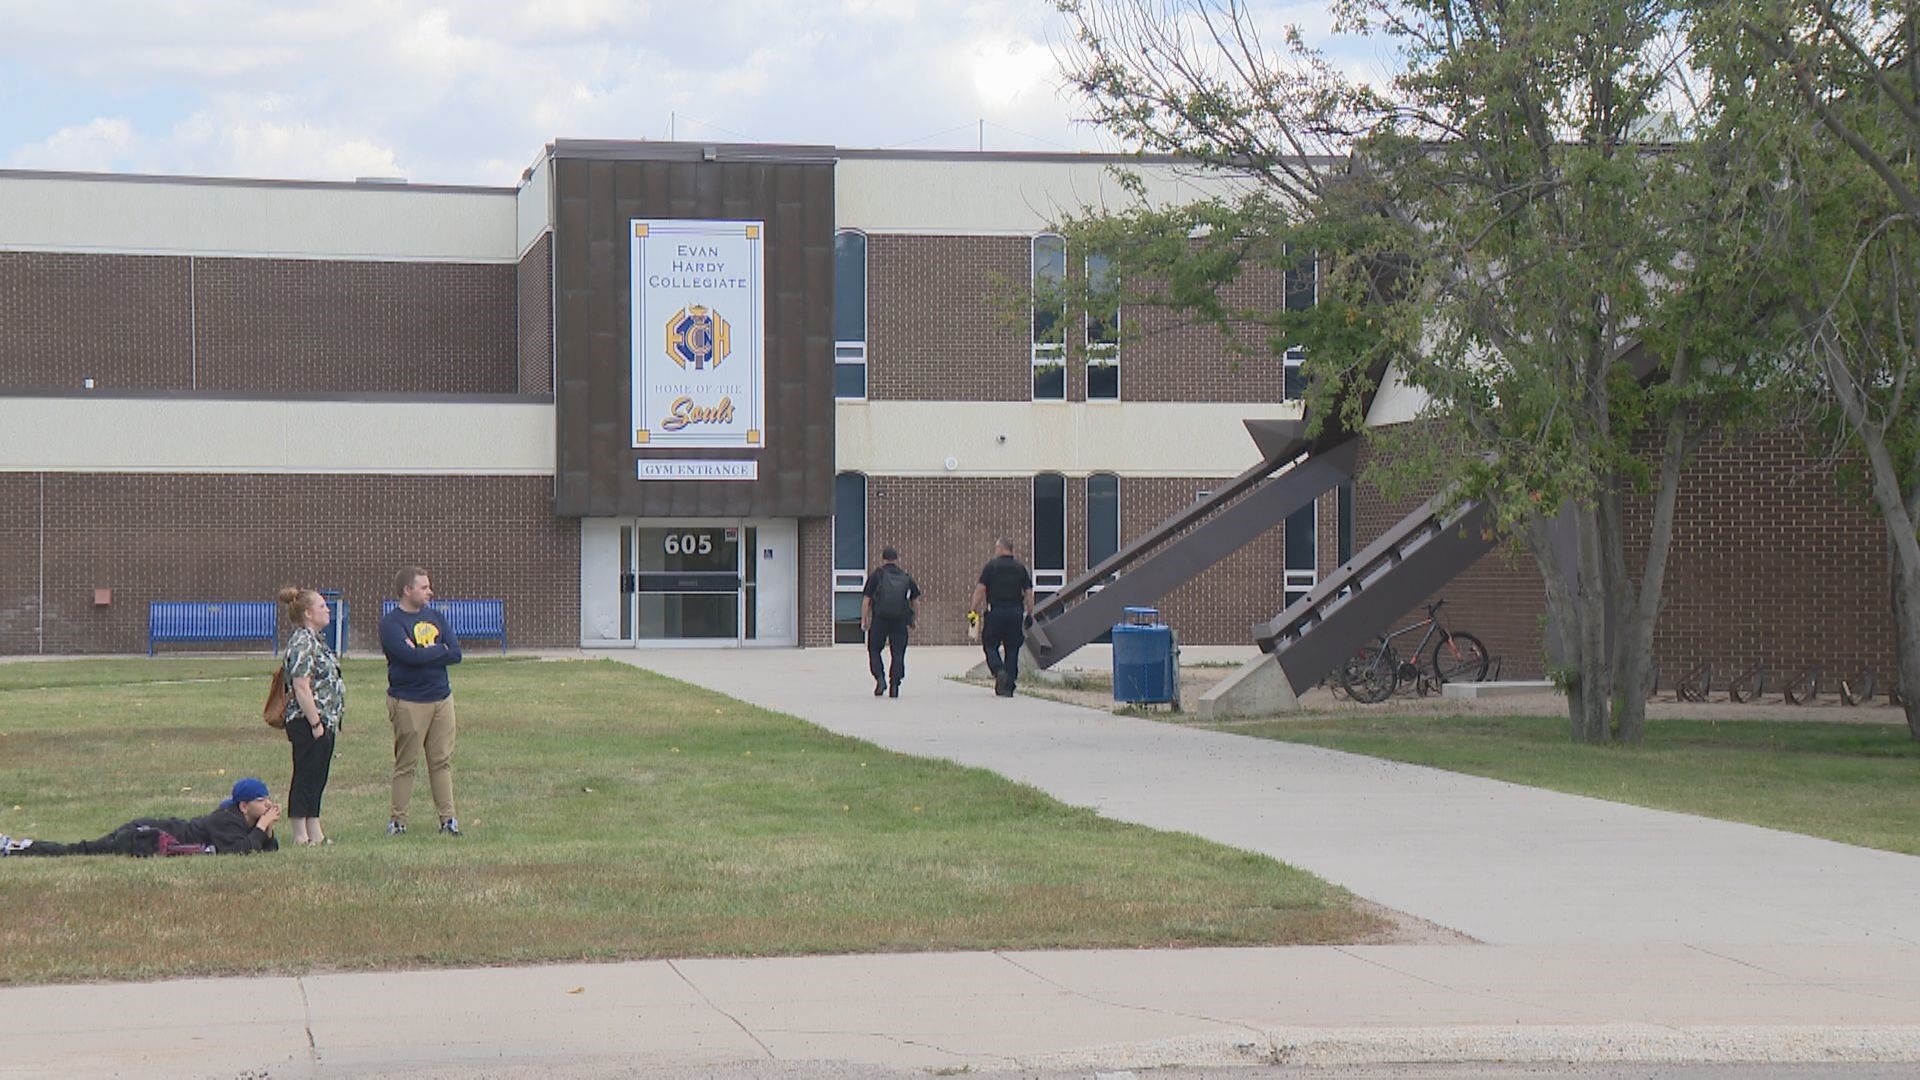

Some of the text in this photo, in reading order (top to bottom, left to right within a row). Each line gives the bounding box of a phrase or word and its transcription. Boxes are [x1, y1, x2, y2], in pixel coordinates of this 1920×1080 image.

[677, 245, 719, 257] EVAN
[672, 260, 725, 273] HARDY
[649, 275, 747, 289] COLLEGIATE
[655, 384, 742, 394] HOME OF THE
[661, 396, 735, 432] Souls
[645, 464, 749, 476] GYM ENTRANCE
[664, 534, 713, 555] 605
